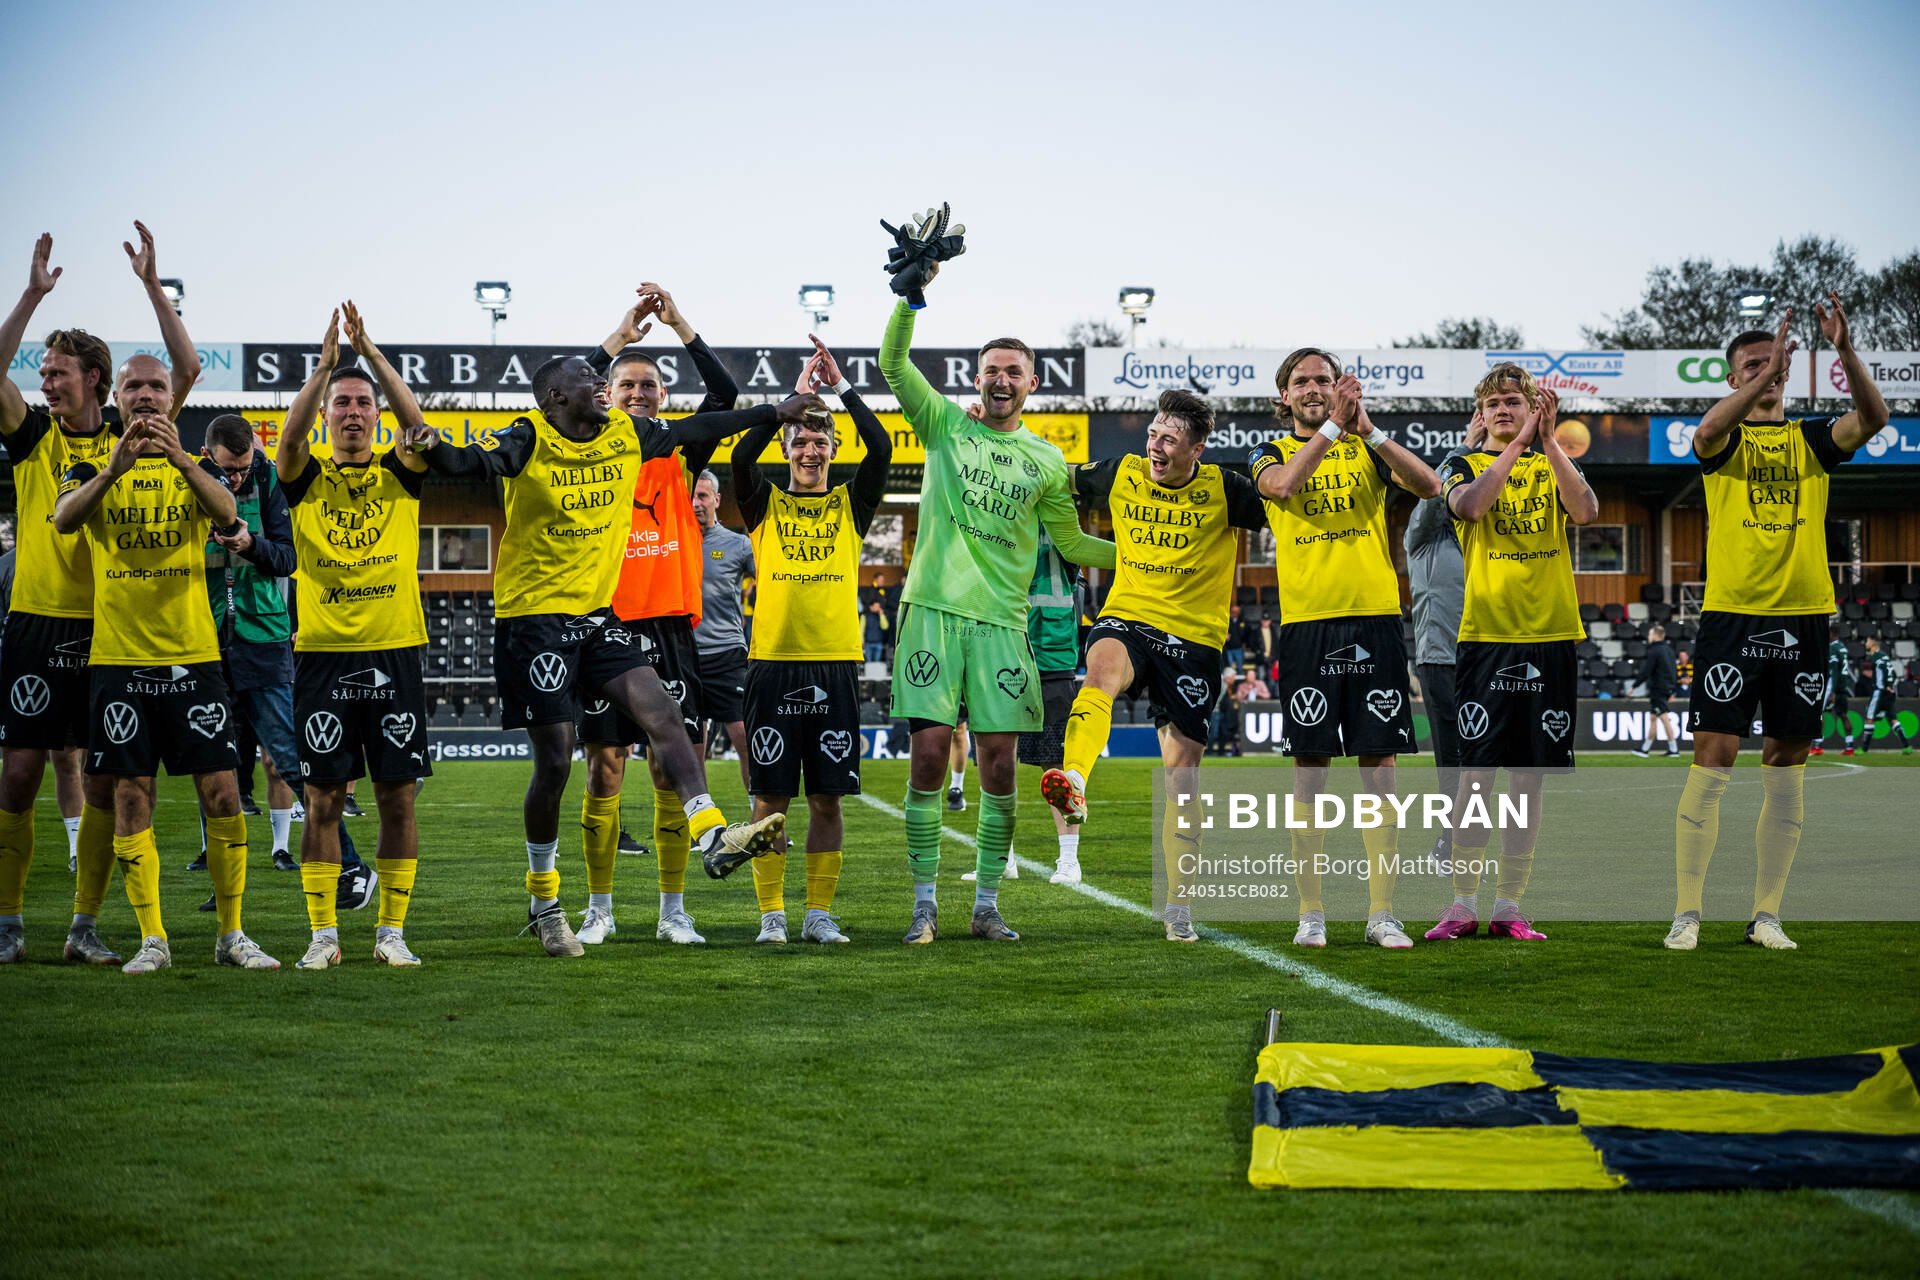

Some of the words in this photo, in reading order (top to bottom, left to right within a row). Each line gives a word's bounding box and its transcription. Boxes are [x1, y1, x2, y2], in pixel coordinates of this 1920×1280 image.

[1114, 352, 1255, 389] Lönneberga
[133, 479, 163, 489] MAXI
[550, 464, 624, 487] MELLBY
[958, 464, 1031, 504] MELLBY
[561, 488, 615, 511] GÅRD
[962, 489, 1017, 520] GÅRD
[1151, 489, 1178, 503] MAXI
[106, 504, 193, 525] MELLBY
[1122, 503, 1206, 528] MELLBY
[116, 528, 182, 549] GÅRD
[327, 528, 381, 549] GÅRD
[1129, 525, 1189, 549] GÅRD
[127, 680, 197, 695] SÄLJFAST
[332, 688, 396, 700] SÄLJFAST
[1489, 680, 1545, 692] SÄLJFAST
[525, 705, 533, 720] 6
[94, 752, 103, 767] 7
